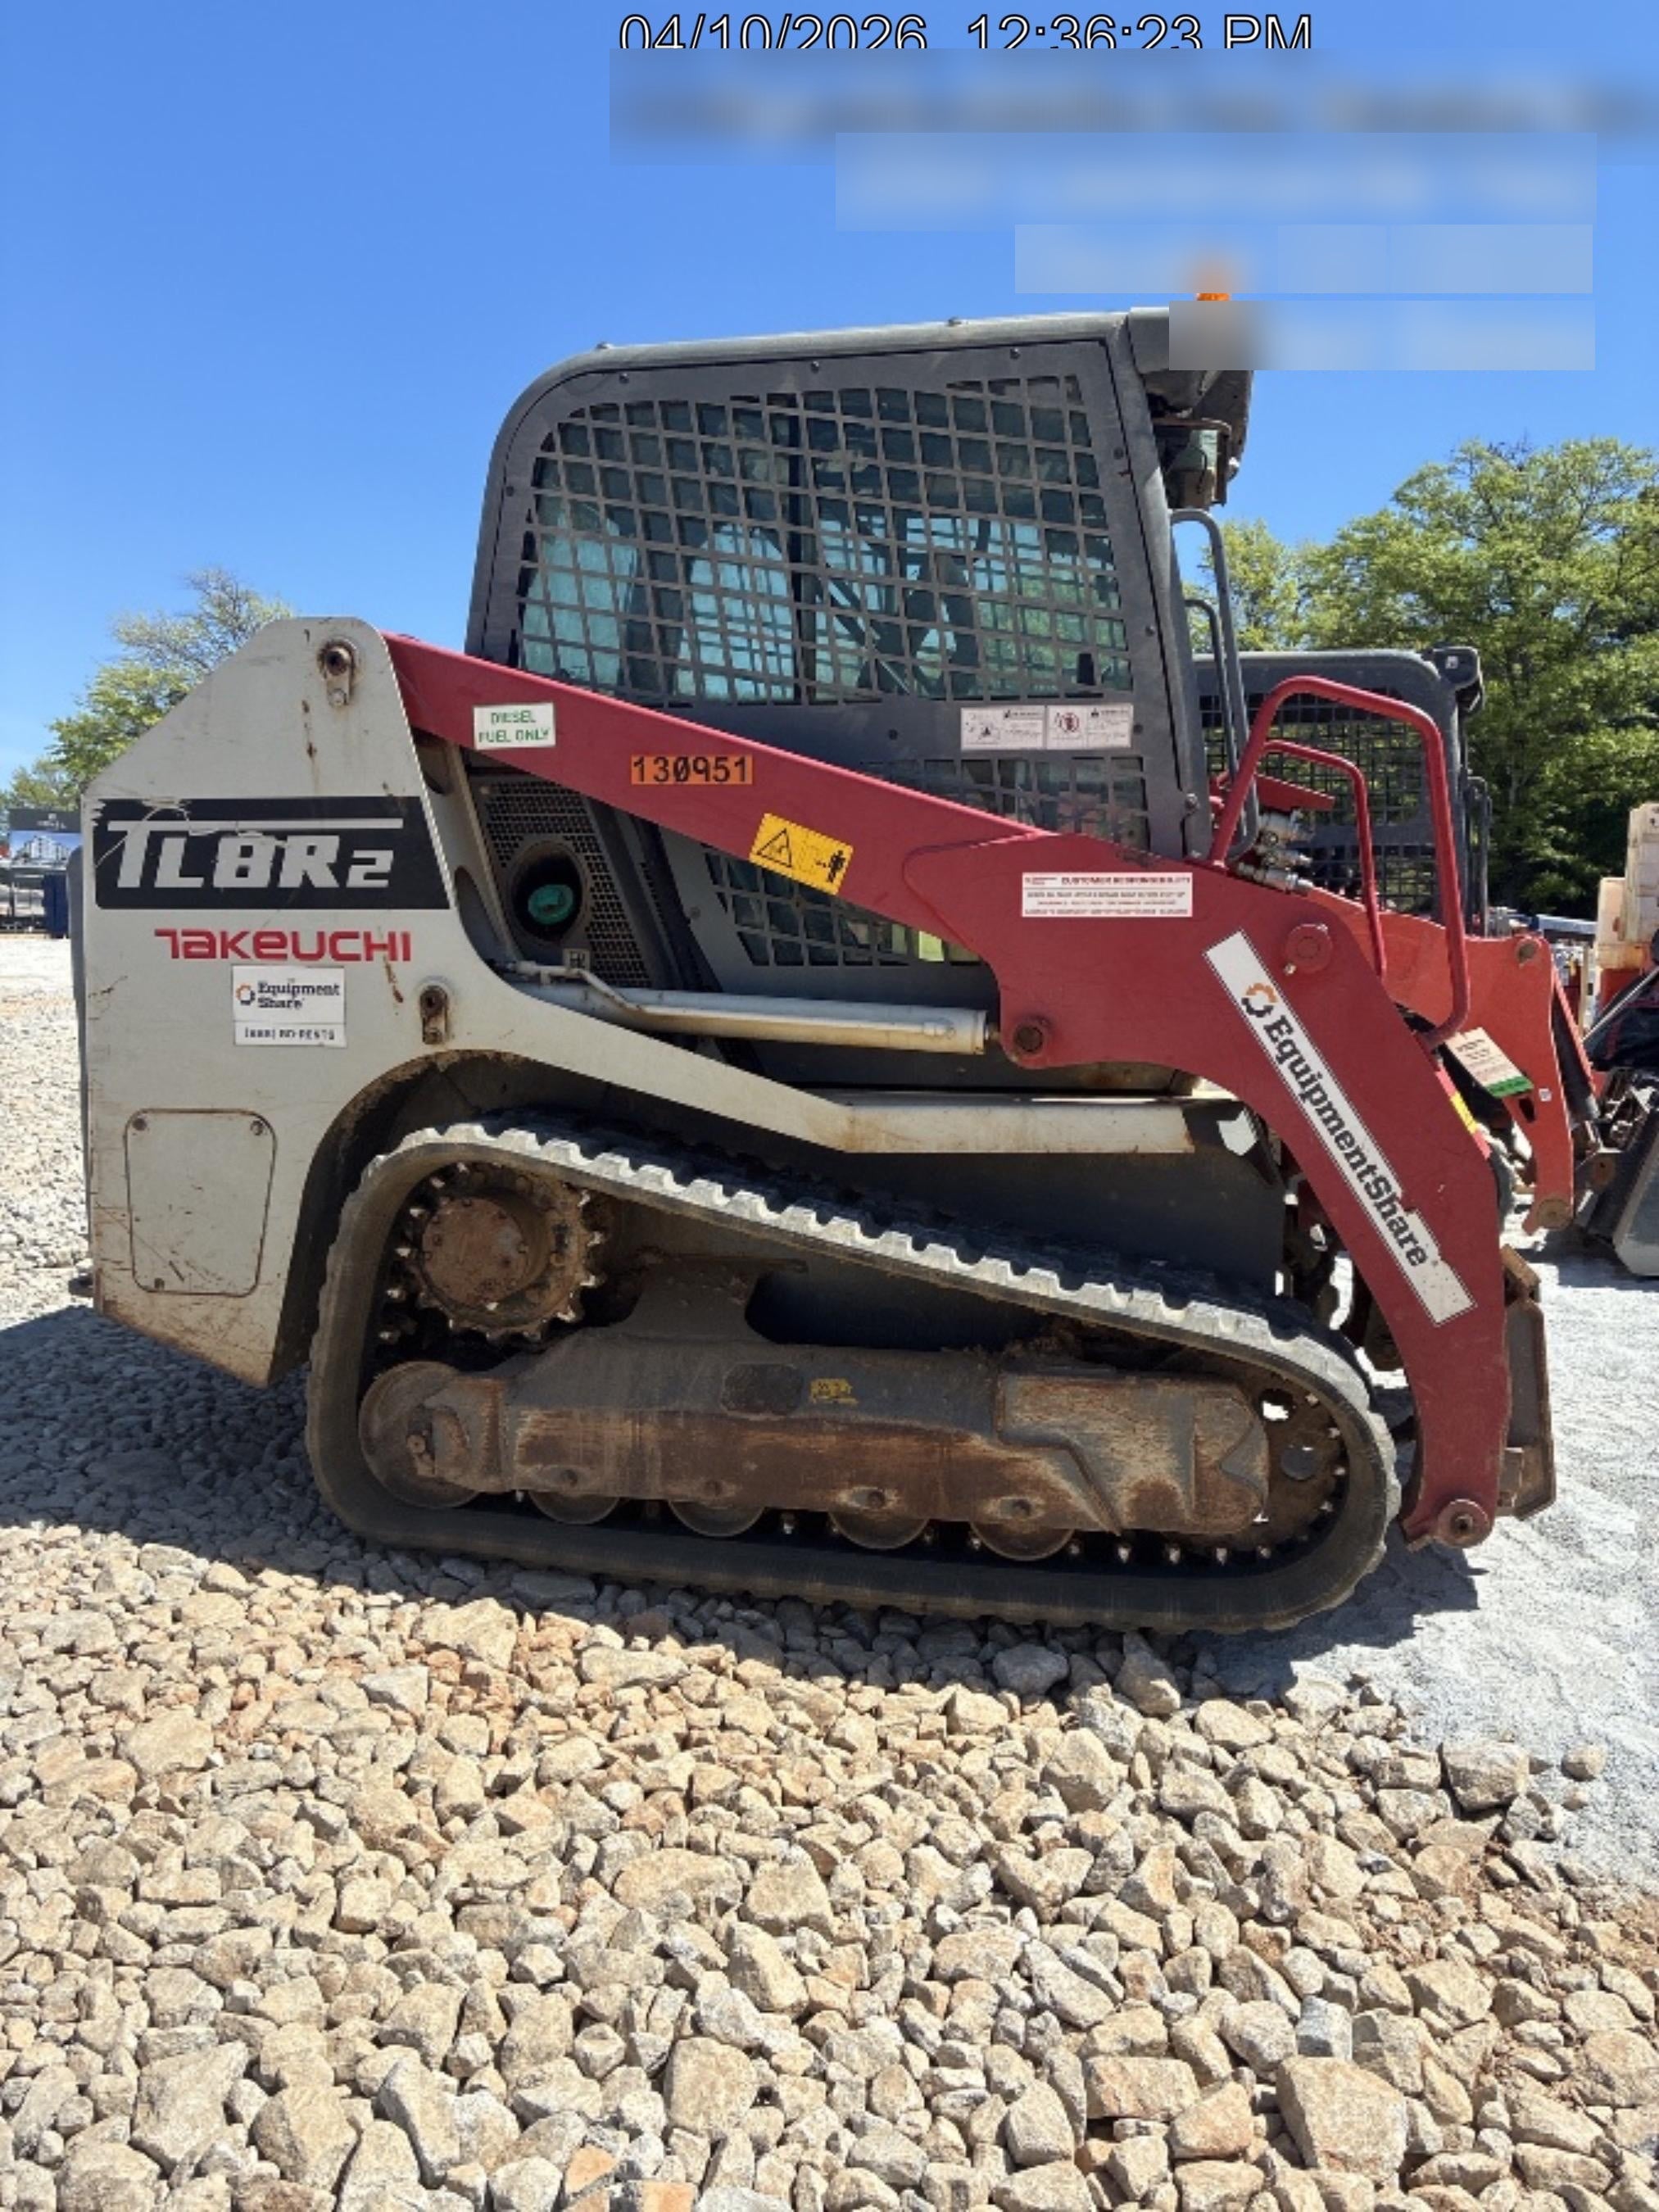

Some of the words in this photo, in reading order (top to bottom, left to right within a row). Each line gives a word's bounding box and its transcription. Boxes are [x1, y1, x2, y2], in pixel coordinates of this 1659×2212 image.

[491, 709, 537, 724] DIESEL
[478, 729, 512, 743] FUEL
[515, 727, 551, 741] ONLY
[633, 756, 747, 782] 130951
[257, 980, 340, 999] Equipment
[257, 997, 302, 1009] Share
[1264, 1015, 1427, 1267] EquipmentShare
